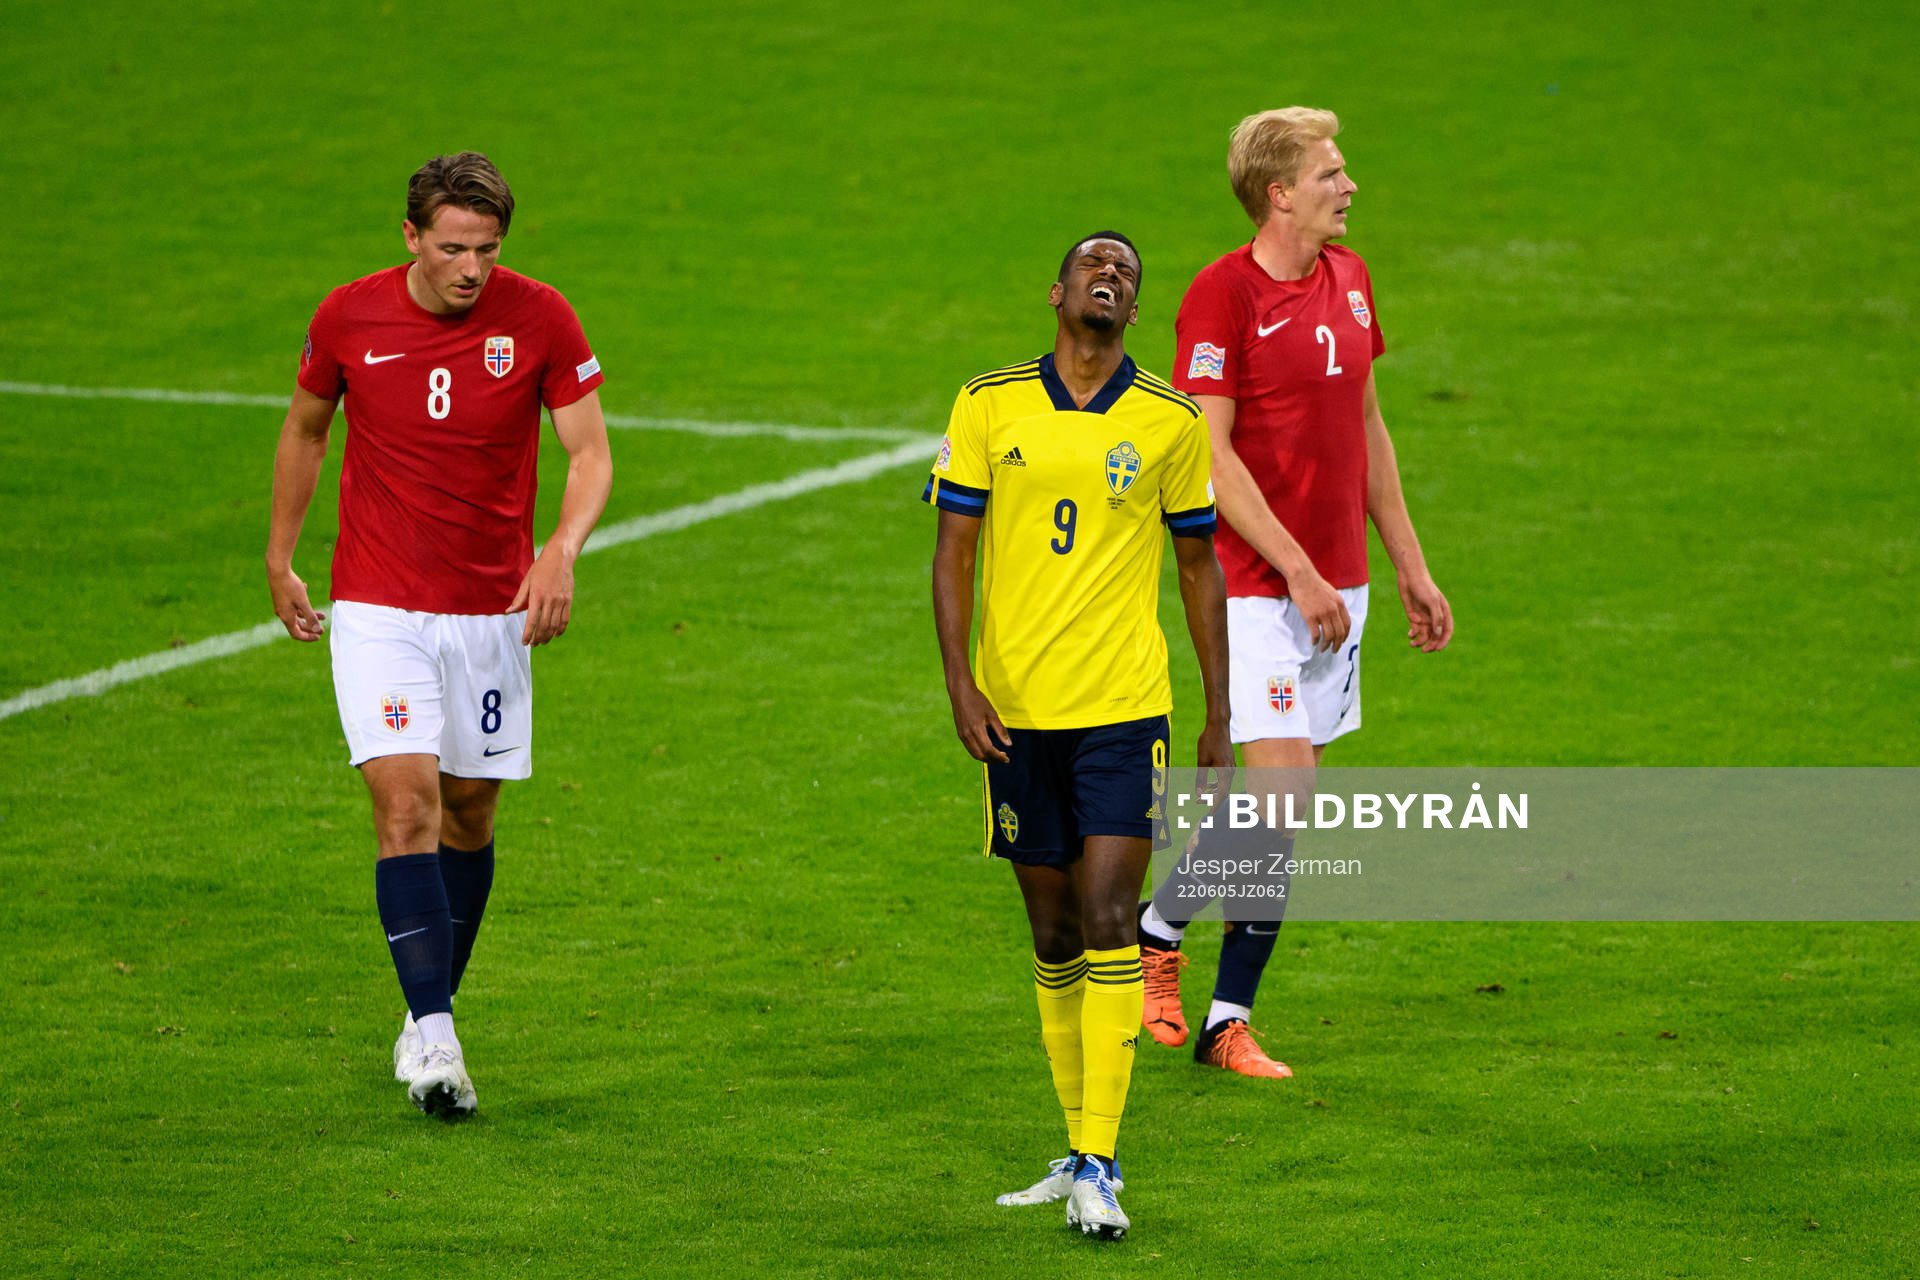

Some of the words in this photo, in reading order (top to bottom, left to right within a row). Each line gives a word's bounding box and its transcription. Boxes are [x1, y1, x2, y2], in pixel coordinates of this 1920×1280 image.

[1315, 324, 1342, 376] 2
[427, 367, 451, 420] 8
[1000, 458, 1027, 467] adidas
[1050, 498, 1078, 555] 9
[481, 689, 502, 734] 8
[1152, 738, 1166, 796] 9
